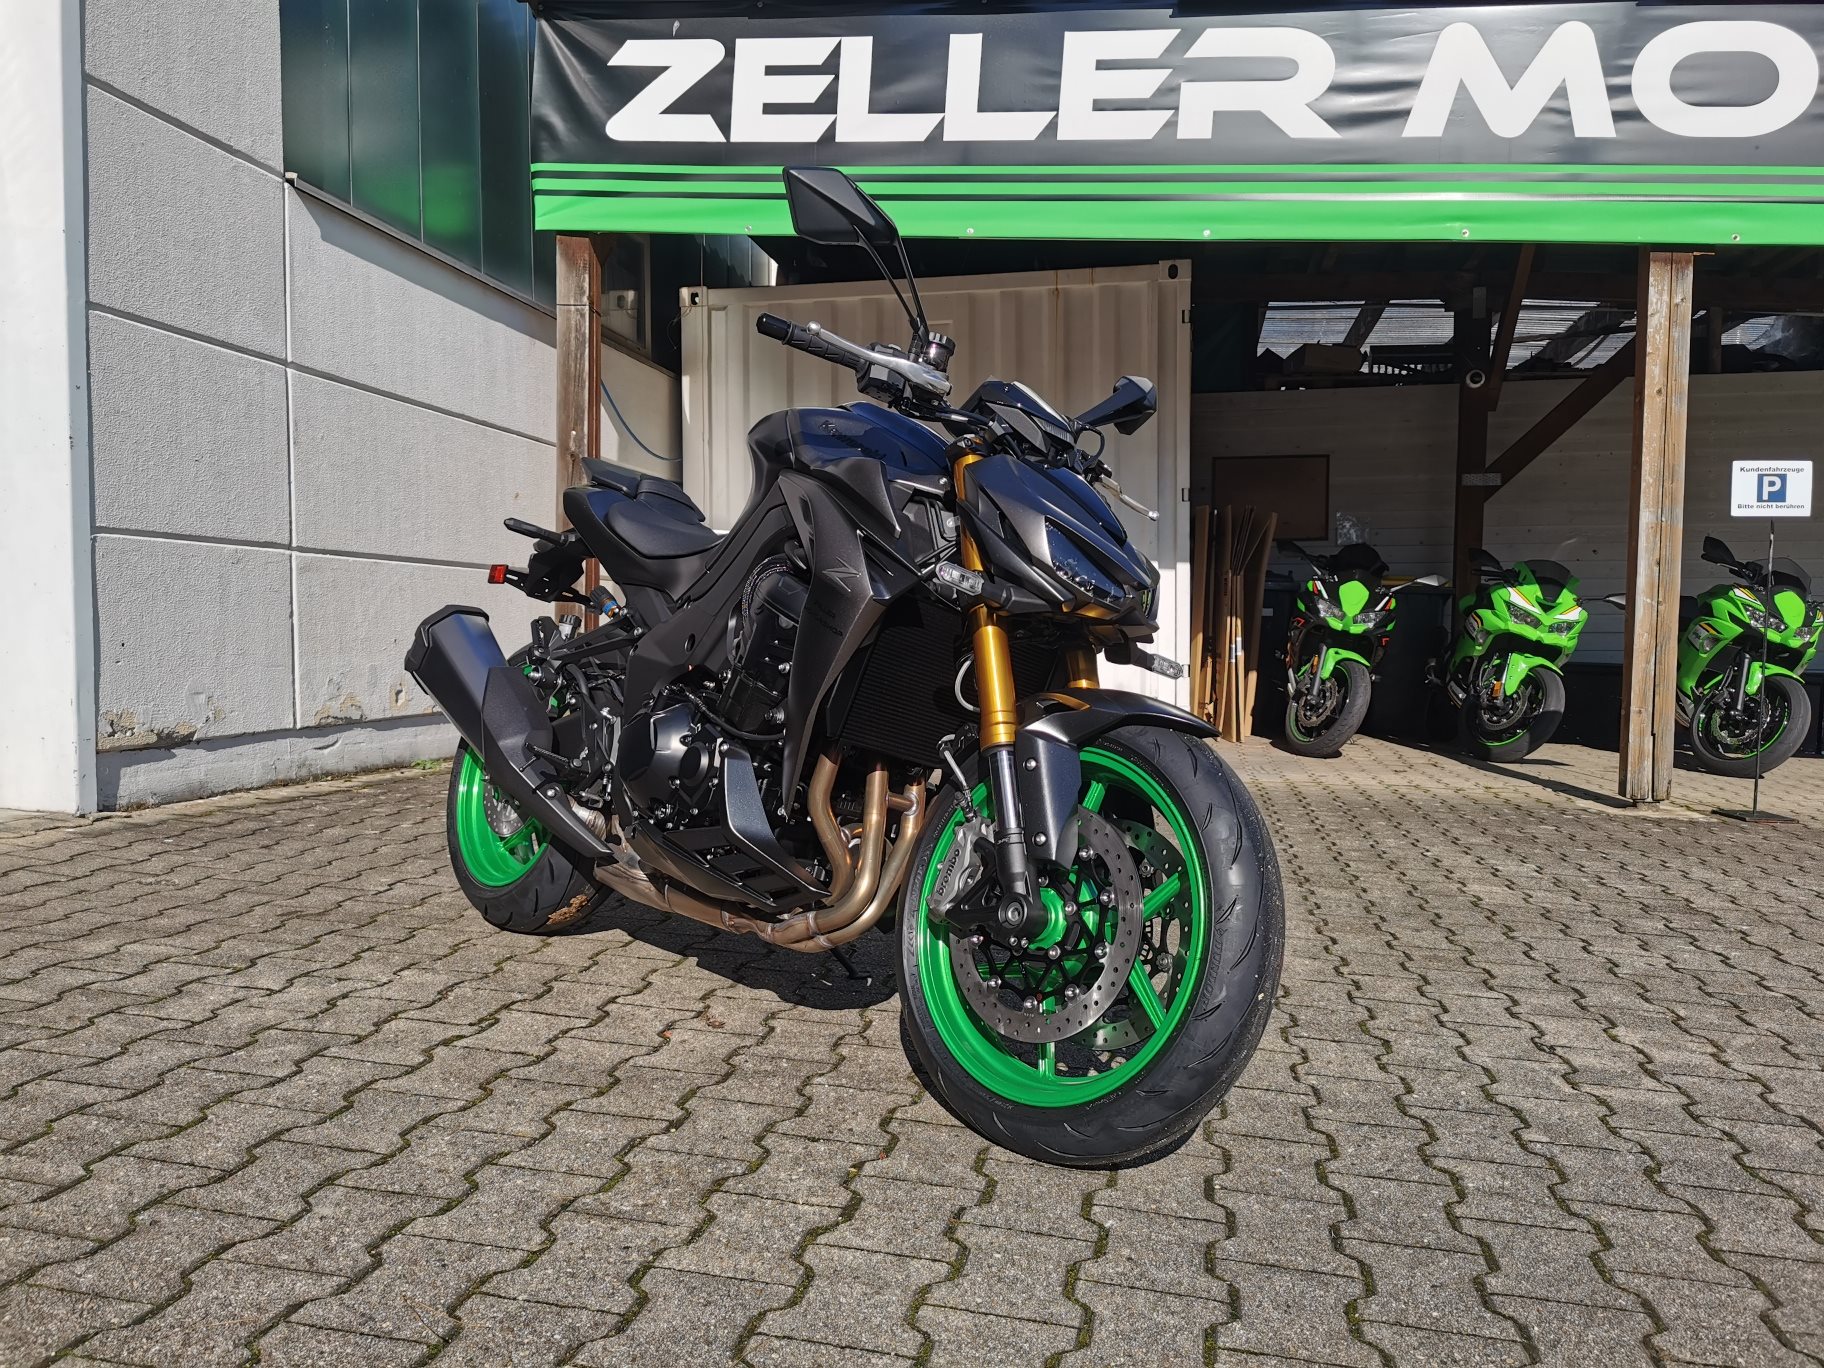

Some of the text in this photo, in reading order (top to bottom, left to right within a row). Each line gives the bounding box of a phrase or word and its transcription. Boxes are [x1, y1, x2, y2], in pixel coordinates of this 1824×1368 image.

[605, 20, 1819, 143] ZELLER MO
[1739, 466, 1805, 474] Kundenfahrzeuge
[1762, 475, 1782, 501] P
[937, 848, 960, 896] brembo
